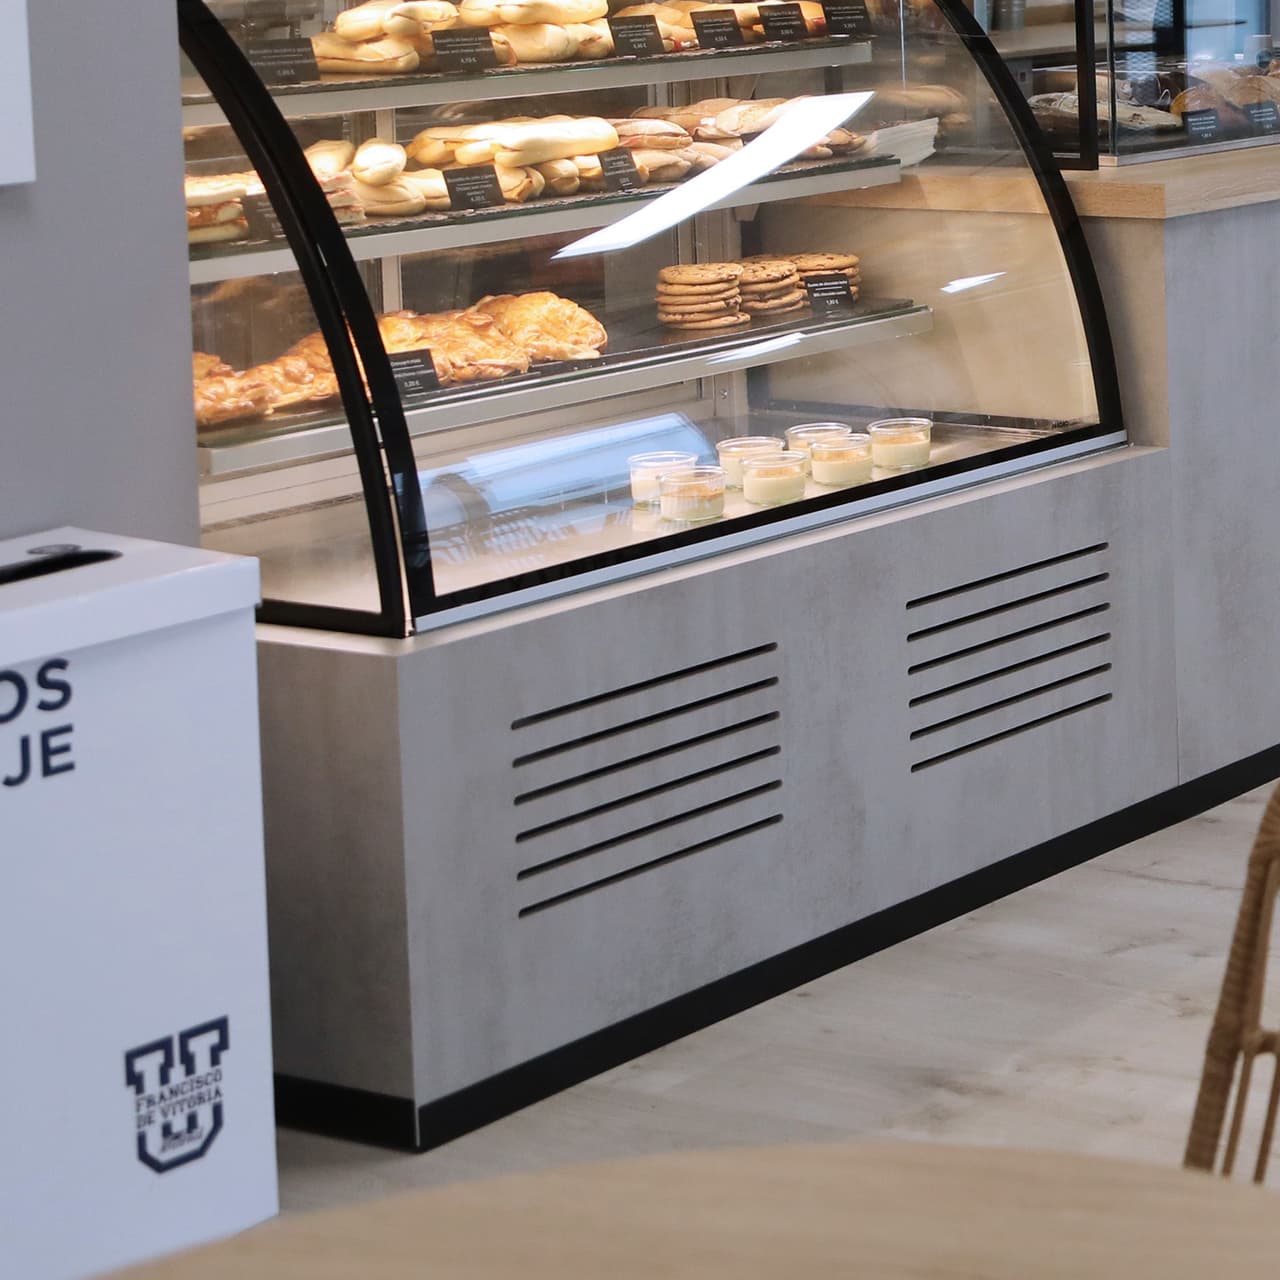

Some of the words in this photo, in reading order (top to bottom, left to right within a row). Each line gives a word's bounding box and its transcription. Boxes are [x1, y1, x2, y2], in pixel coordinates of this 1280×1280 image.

[2, 723, 76, 788] JE
[135, 1067, 223, 1113] FRANCISCO
[137, 1111, 156, 1130] DE
[160, 1087, 223, 1121] VITORIA
